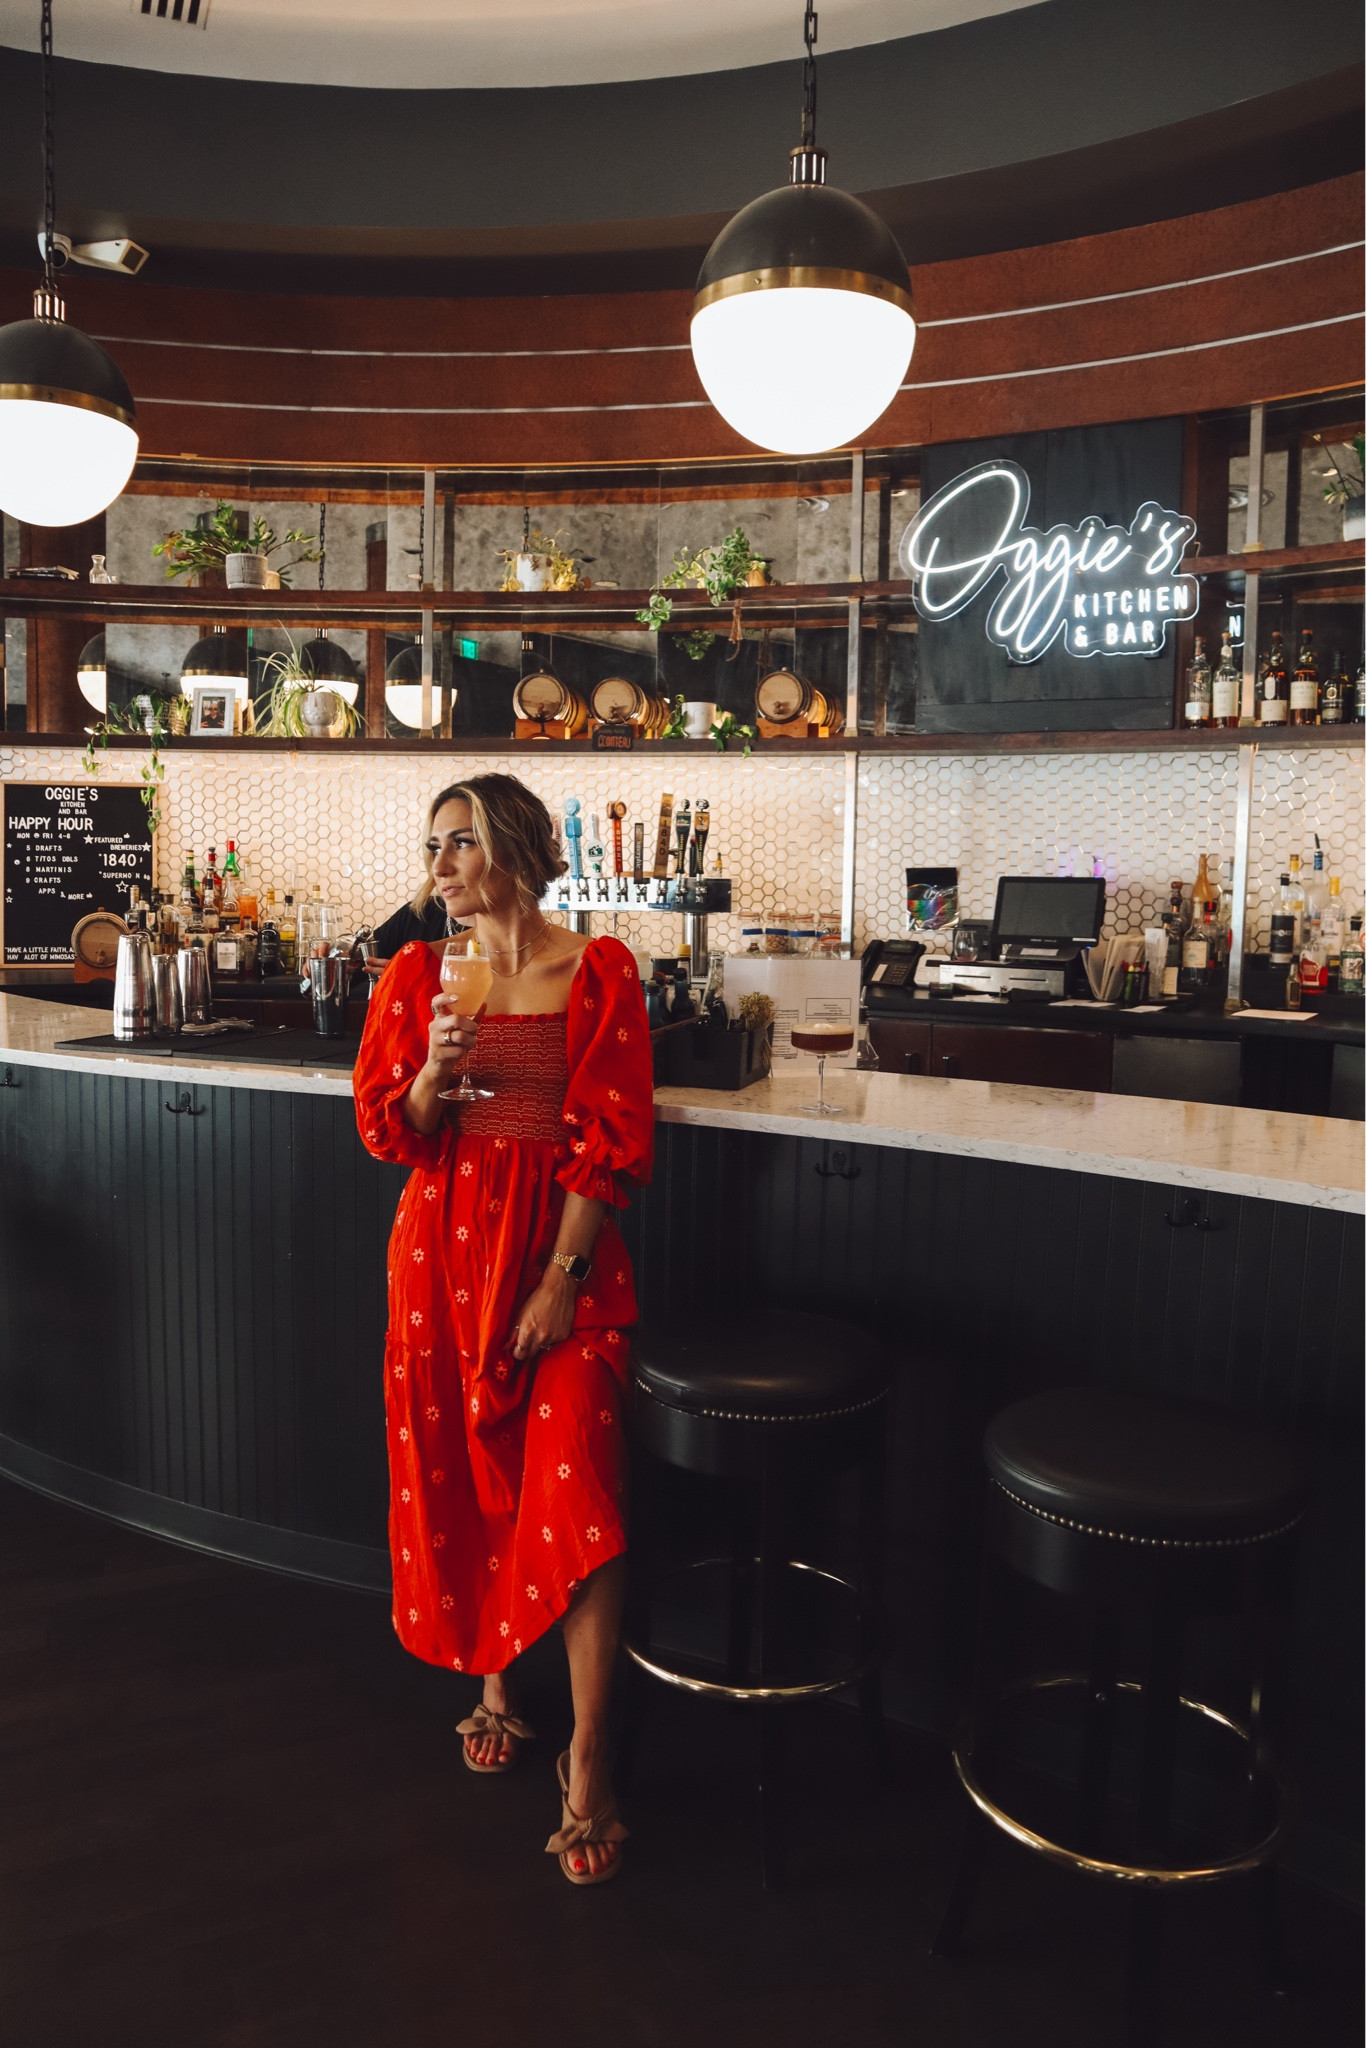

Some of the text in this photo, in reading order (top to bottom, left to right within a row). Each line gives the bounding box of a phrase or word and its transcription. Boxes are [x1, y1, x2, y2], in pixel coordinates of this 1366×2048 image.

[907, 468, 1186, 653] Oggie's
[1073, 584, 1190, 619] KITCHEN
[1073, 621, 1155, 648] & BAR
[45, 786, 99, 801] OGGIE'S
[8, 816, 94, 831] HAPPY HOUR
[103, 853, 137, 867] 1840
[38, 887, 56, 895] APPS
